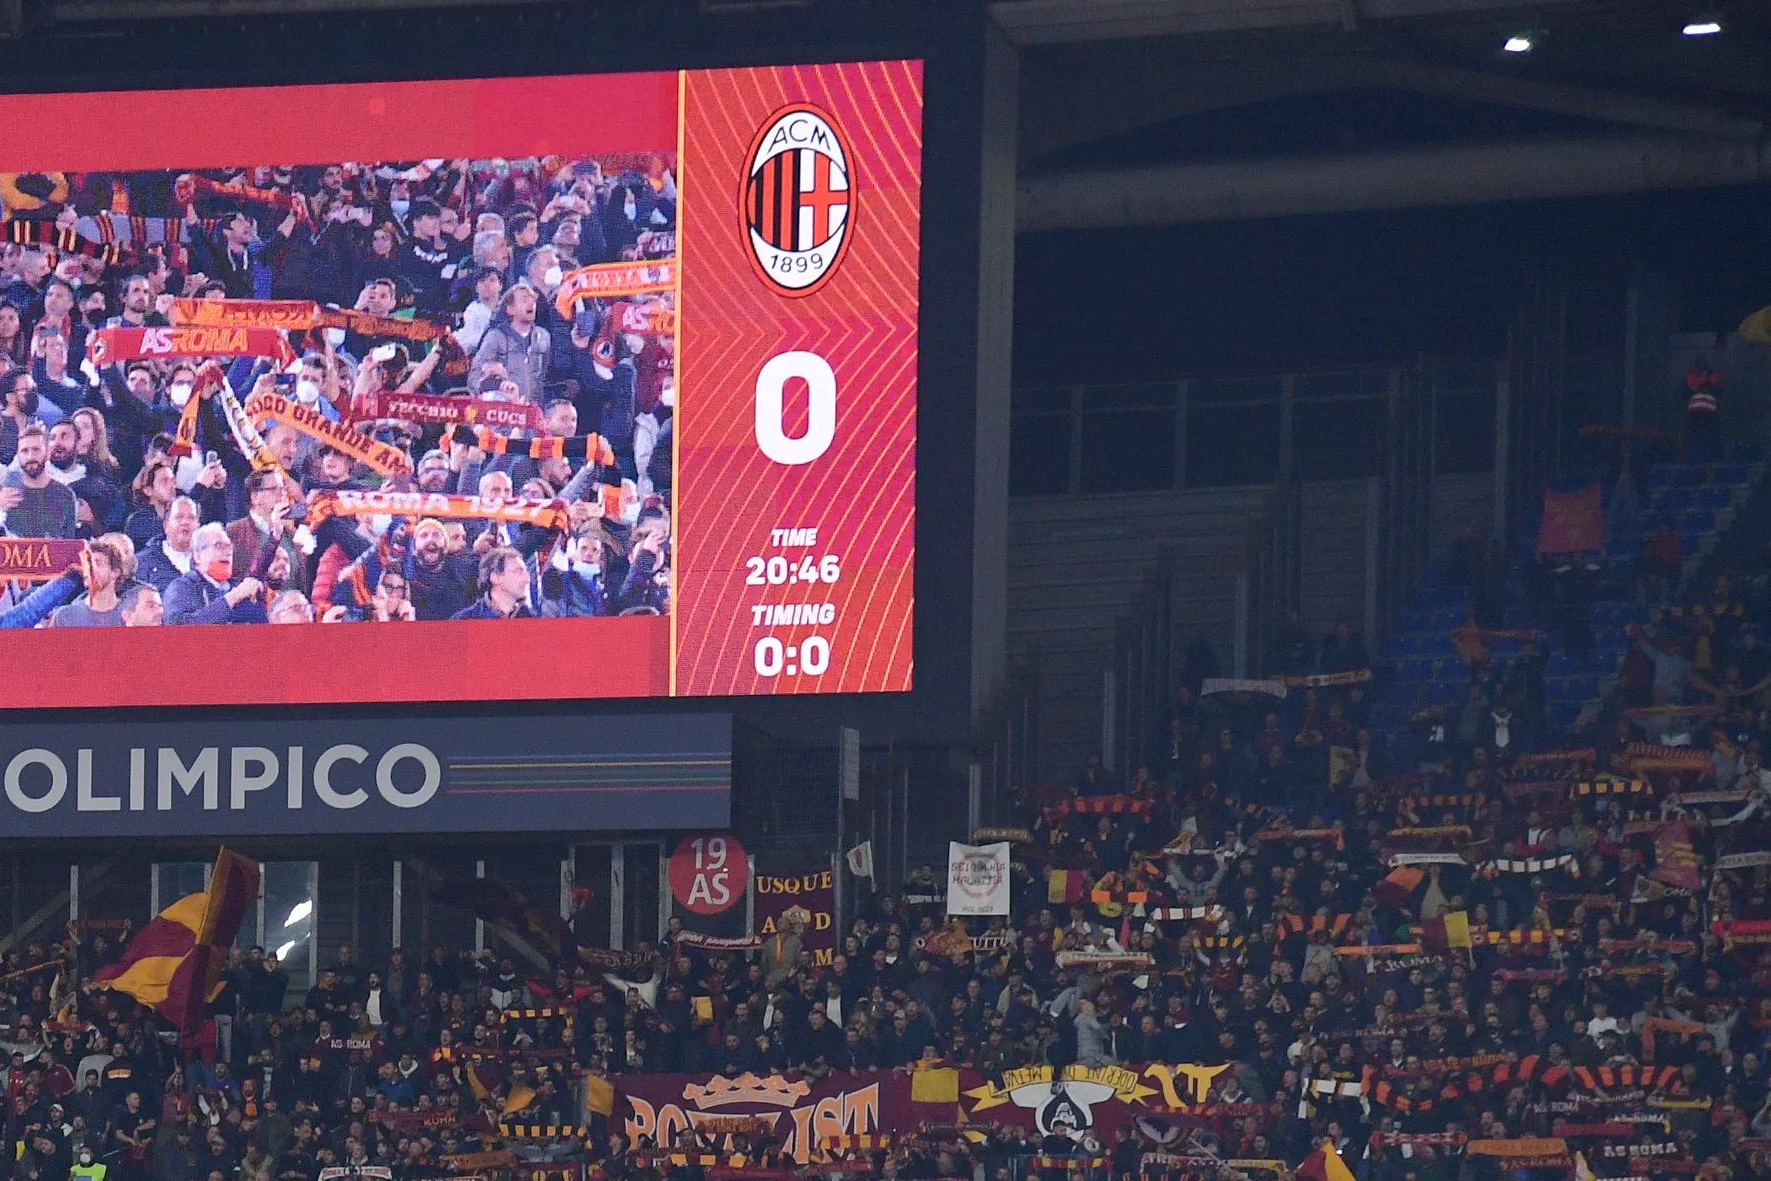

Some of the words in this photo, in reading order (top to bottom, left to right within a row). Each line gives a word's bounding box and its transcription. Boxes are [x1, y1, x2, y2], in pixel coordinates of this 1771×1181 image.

[766, 119, 831, 153] ACM
[770, 252, 824, 274] 1899
[755, 350, 836, 465] 0
[338, 489, 450, 512] ROMA
[771, 528, 818, 547] TIME
[746, 555, 840, 585] 20:46
[751, 604, 836, 626] TIMING
[754, 635, 829, 677] 0:0
[3, 743, 441, 813] OLIMPICO
[691, 837, 727, 870] 19
[687, 874, 730, 906] AS
[756, 870, 833, 895] USQUE
[347, 1038, 371, 1050] ROMA
[1629, 1141, 1677, 1157] ROMA
